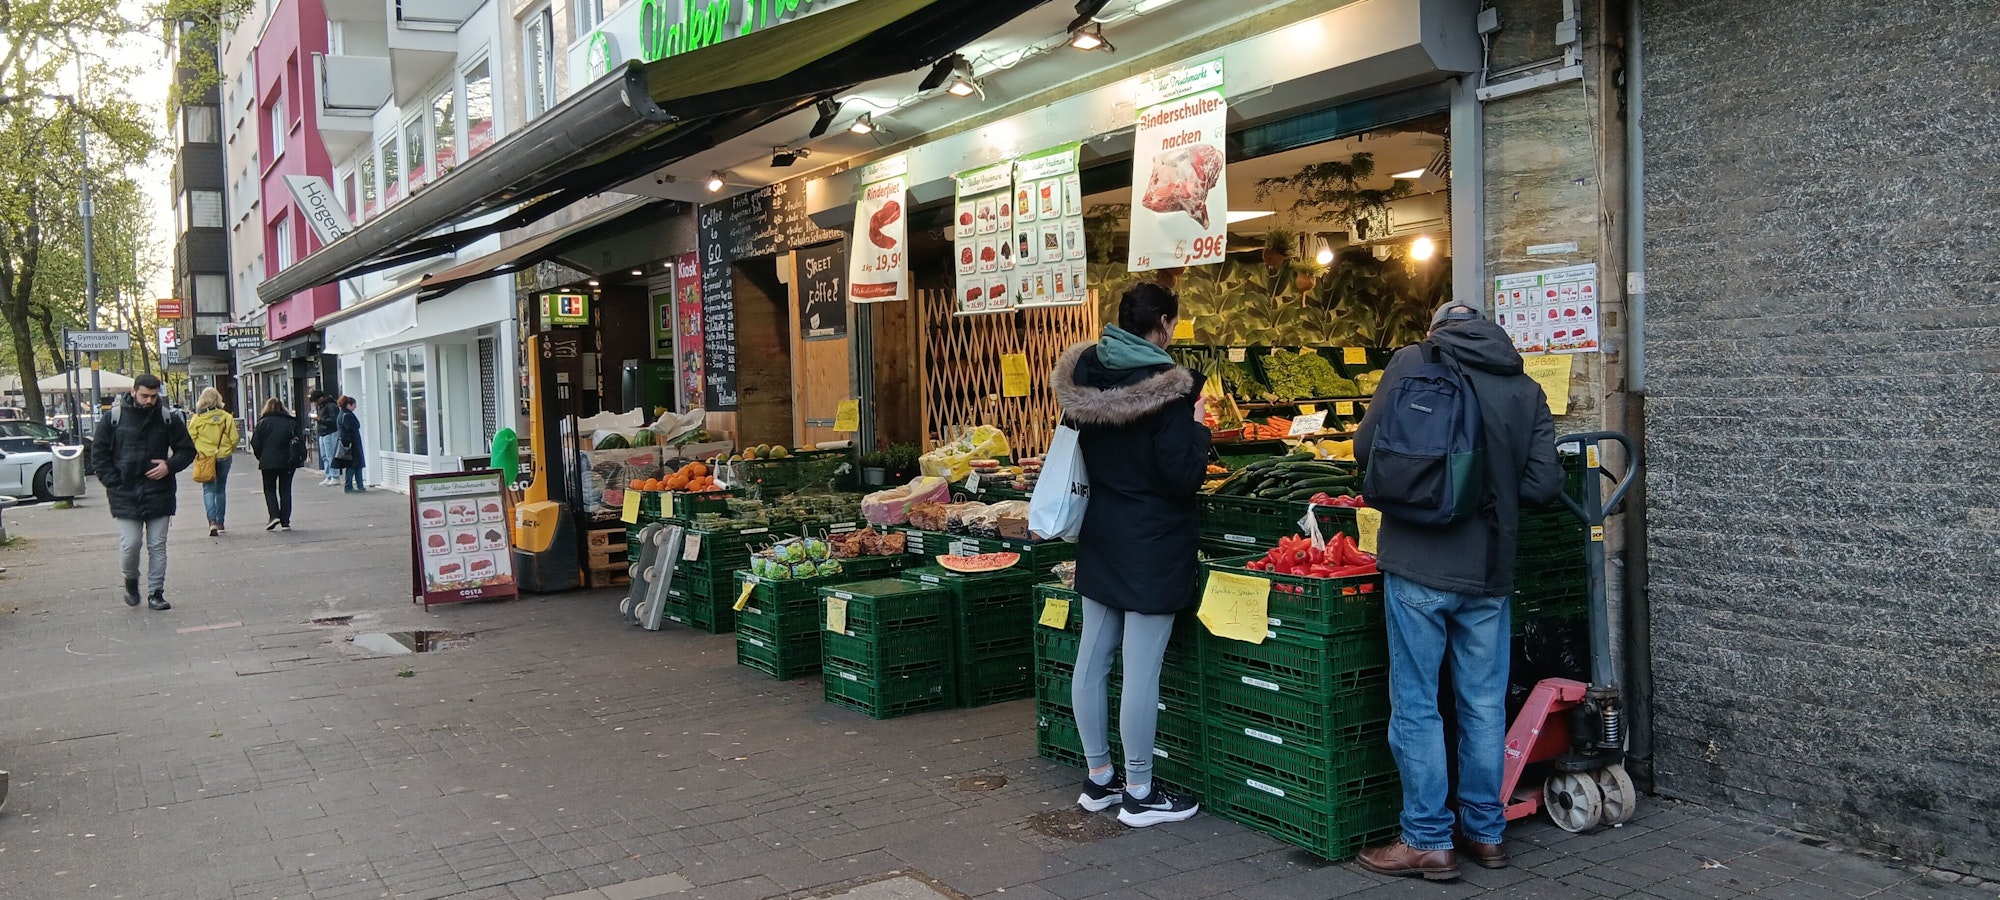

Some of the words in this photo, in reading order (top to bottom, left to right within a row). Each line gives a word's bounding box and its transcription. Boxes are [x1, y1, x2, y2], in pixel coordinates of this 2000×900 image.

[1162, 130, 1201, 150] nacken
[867, 182, 900, 200] Rinderfilet
[702, 208, 722, 229] Coffee
[711, 228, 718, 239] to
[708, 243, 722, 261] GO
[678, 258, 697, 279] Kiosk
[806, 256, 831, 279] STREET
[1137, 256, 1150, 267] 1kg
[77, 334, 119, 342] Gymnasium
[229, 327, 259, 336] SAPHIR
[460, 588, 483, 596] COSTA
[1226, 600, 1240, 624] 1
